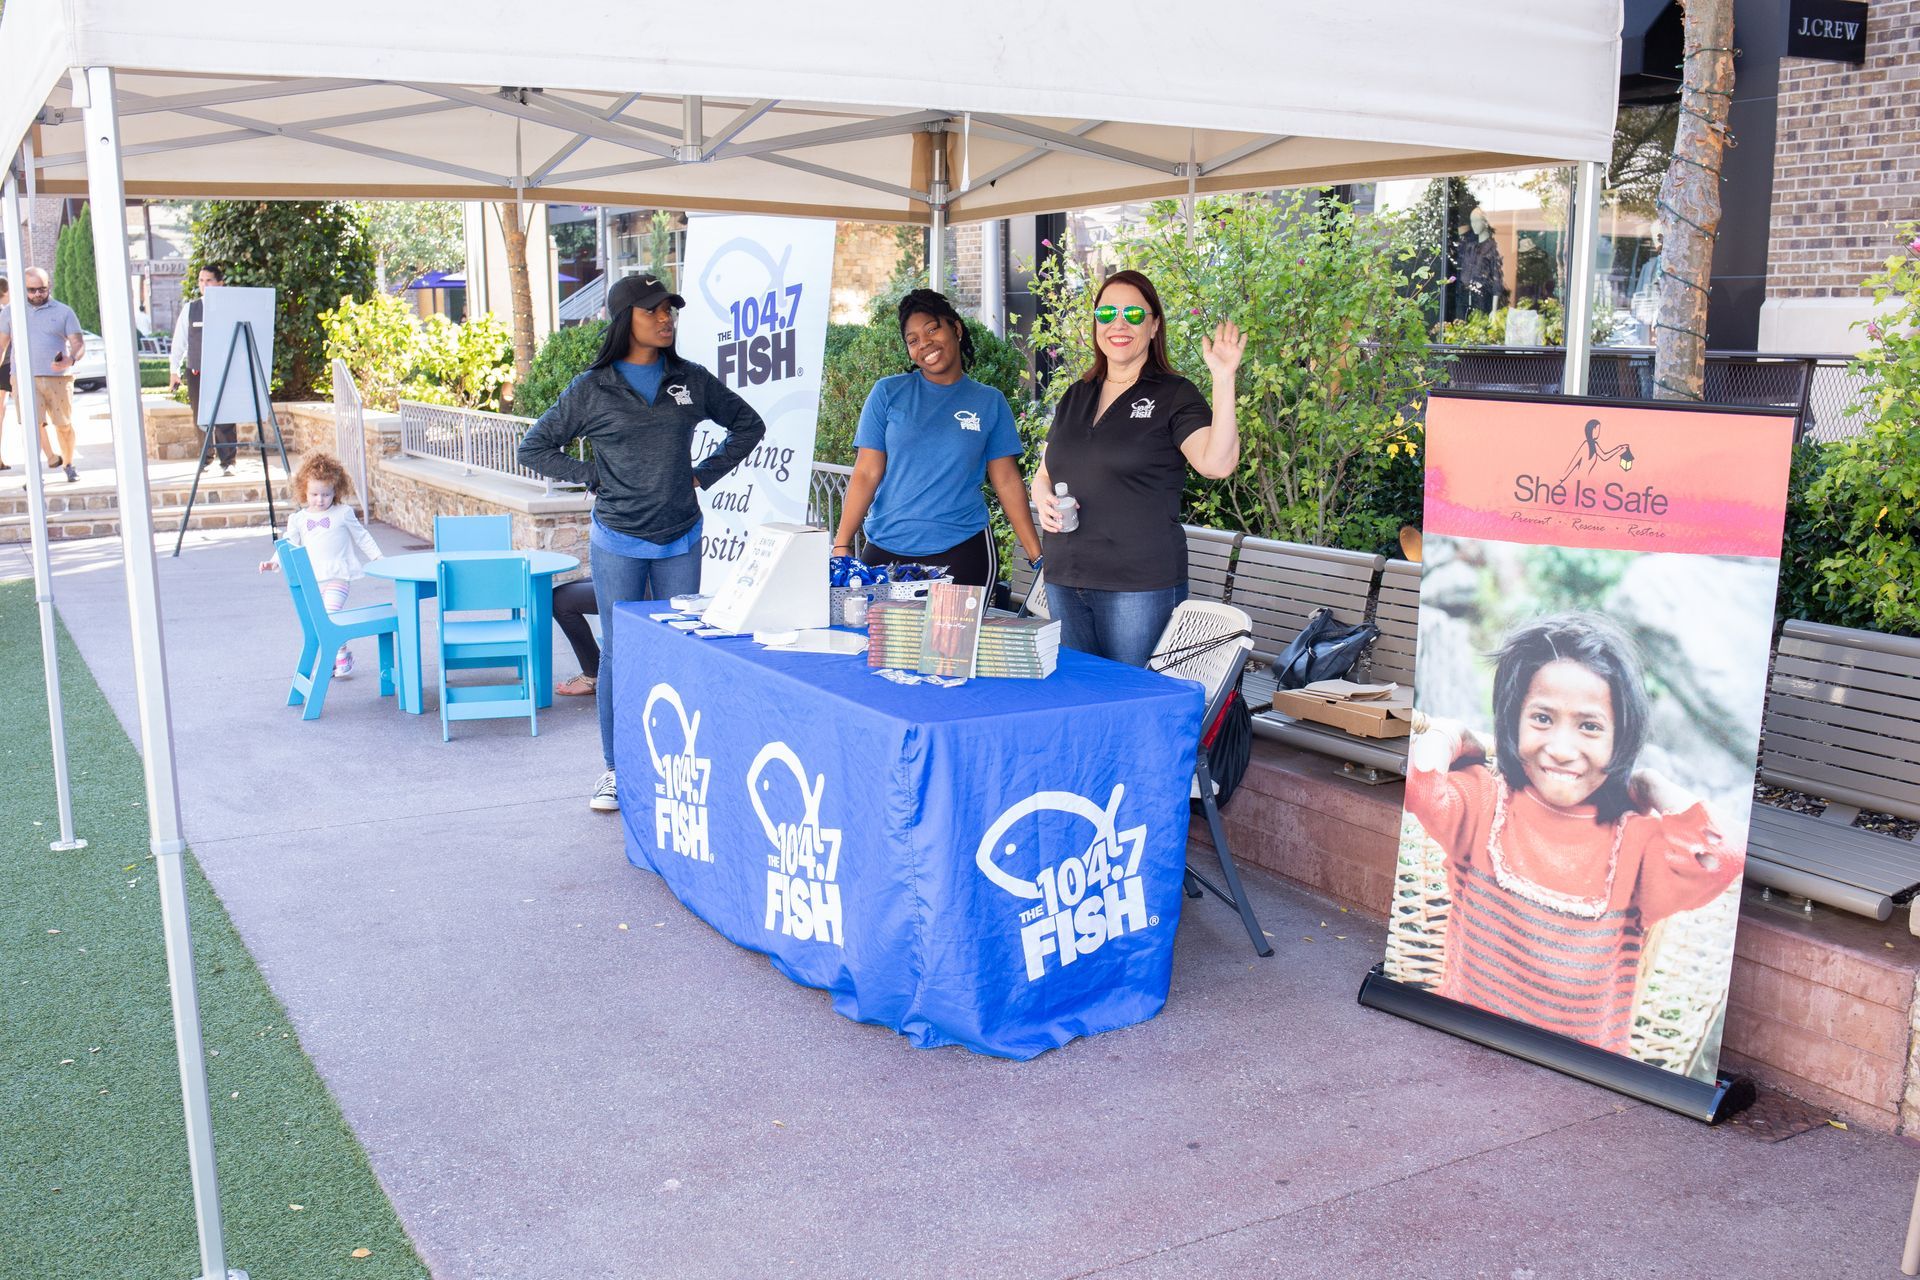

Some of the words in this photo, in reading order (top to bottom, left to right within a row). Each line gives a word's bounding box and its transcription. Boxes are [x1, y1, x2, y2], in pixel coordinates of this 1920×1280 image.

[1797, 17, 1860, 41] J.CREW
[717, 330, 732, 342] THE
[730, 283, 803, 342] 104.7
[717, 328, 797, 389] FISH
[1129, 409, 1152, 419] FISH
[711, 484, 754, 514] and
[1513, 474, 1567, 506] She
[1574, 479, 1597, 509] Is
[1602, 482, 1669, 516] Safe
[701, 528, 748, 562] ositi
[1511, 511, 1552, 525] Prevent
[1571, 518, 1606, 531] Rescue
[1627, 524, 1666, 538] Restore
[654, 782, 666, 795] THE
[661, 754, 712, 805] 104.7
[655, 796, 710, 863] FISH
[767, 854, 780, 868] THE
[777, 822, 842, 882] 104.7
[1018, 904, 1045, 924] THE
[1036, 824, 1148, 917] 104.7
[765, 869, 843, 948] FISH
[1020, 875, 1148, 982] FISH
